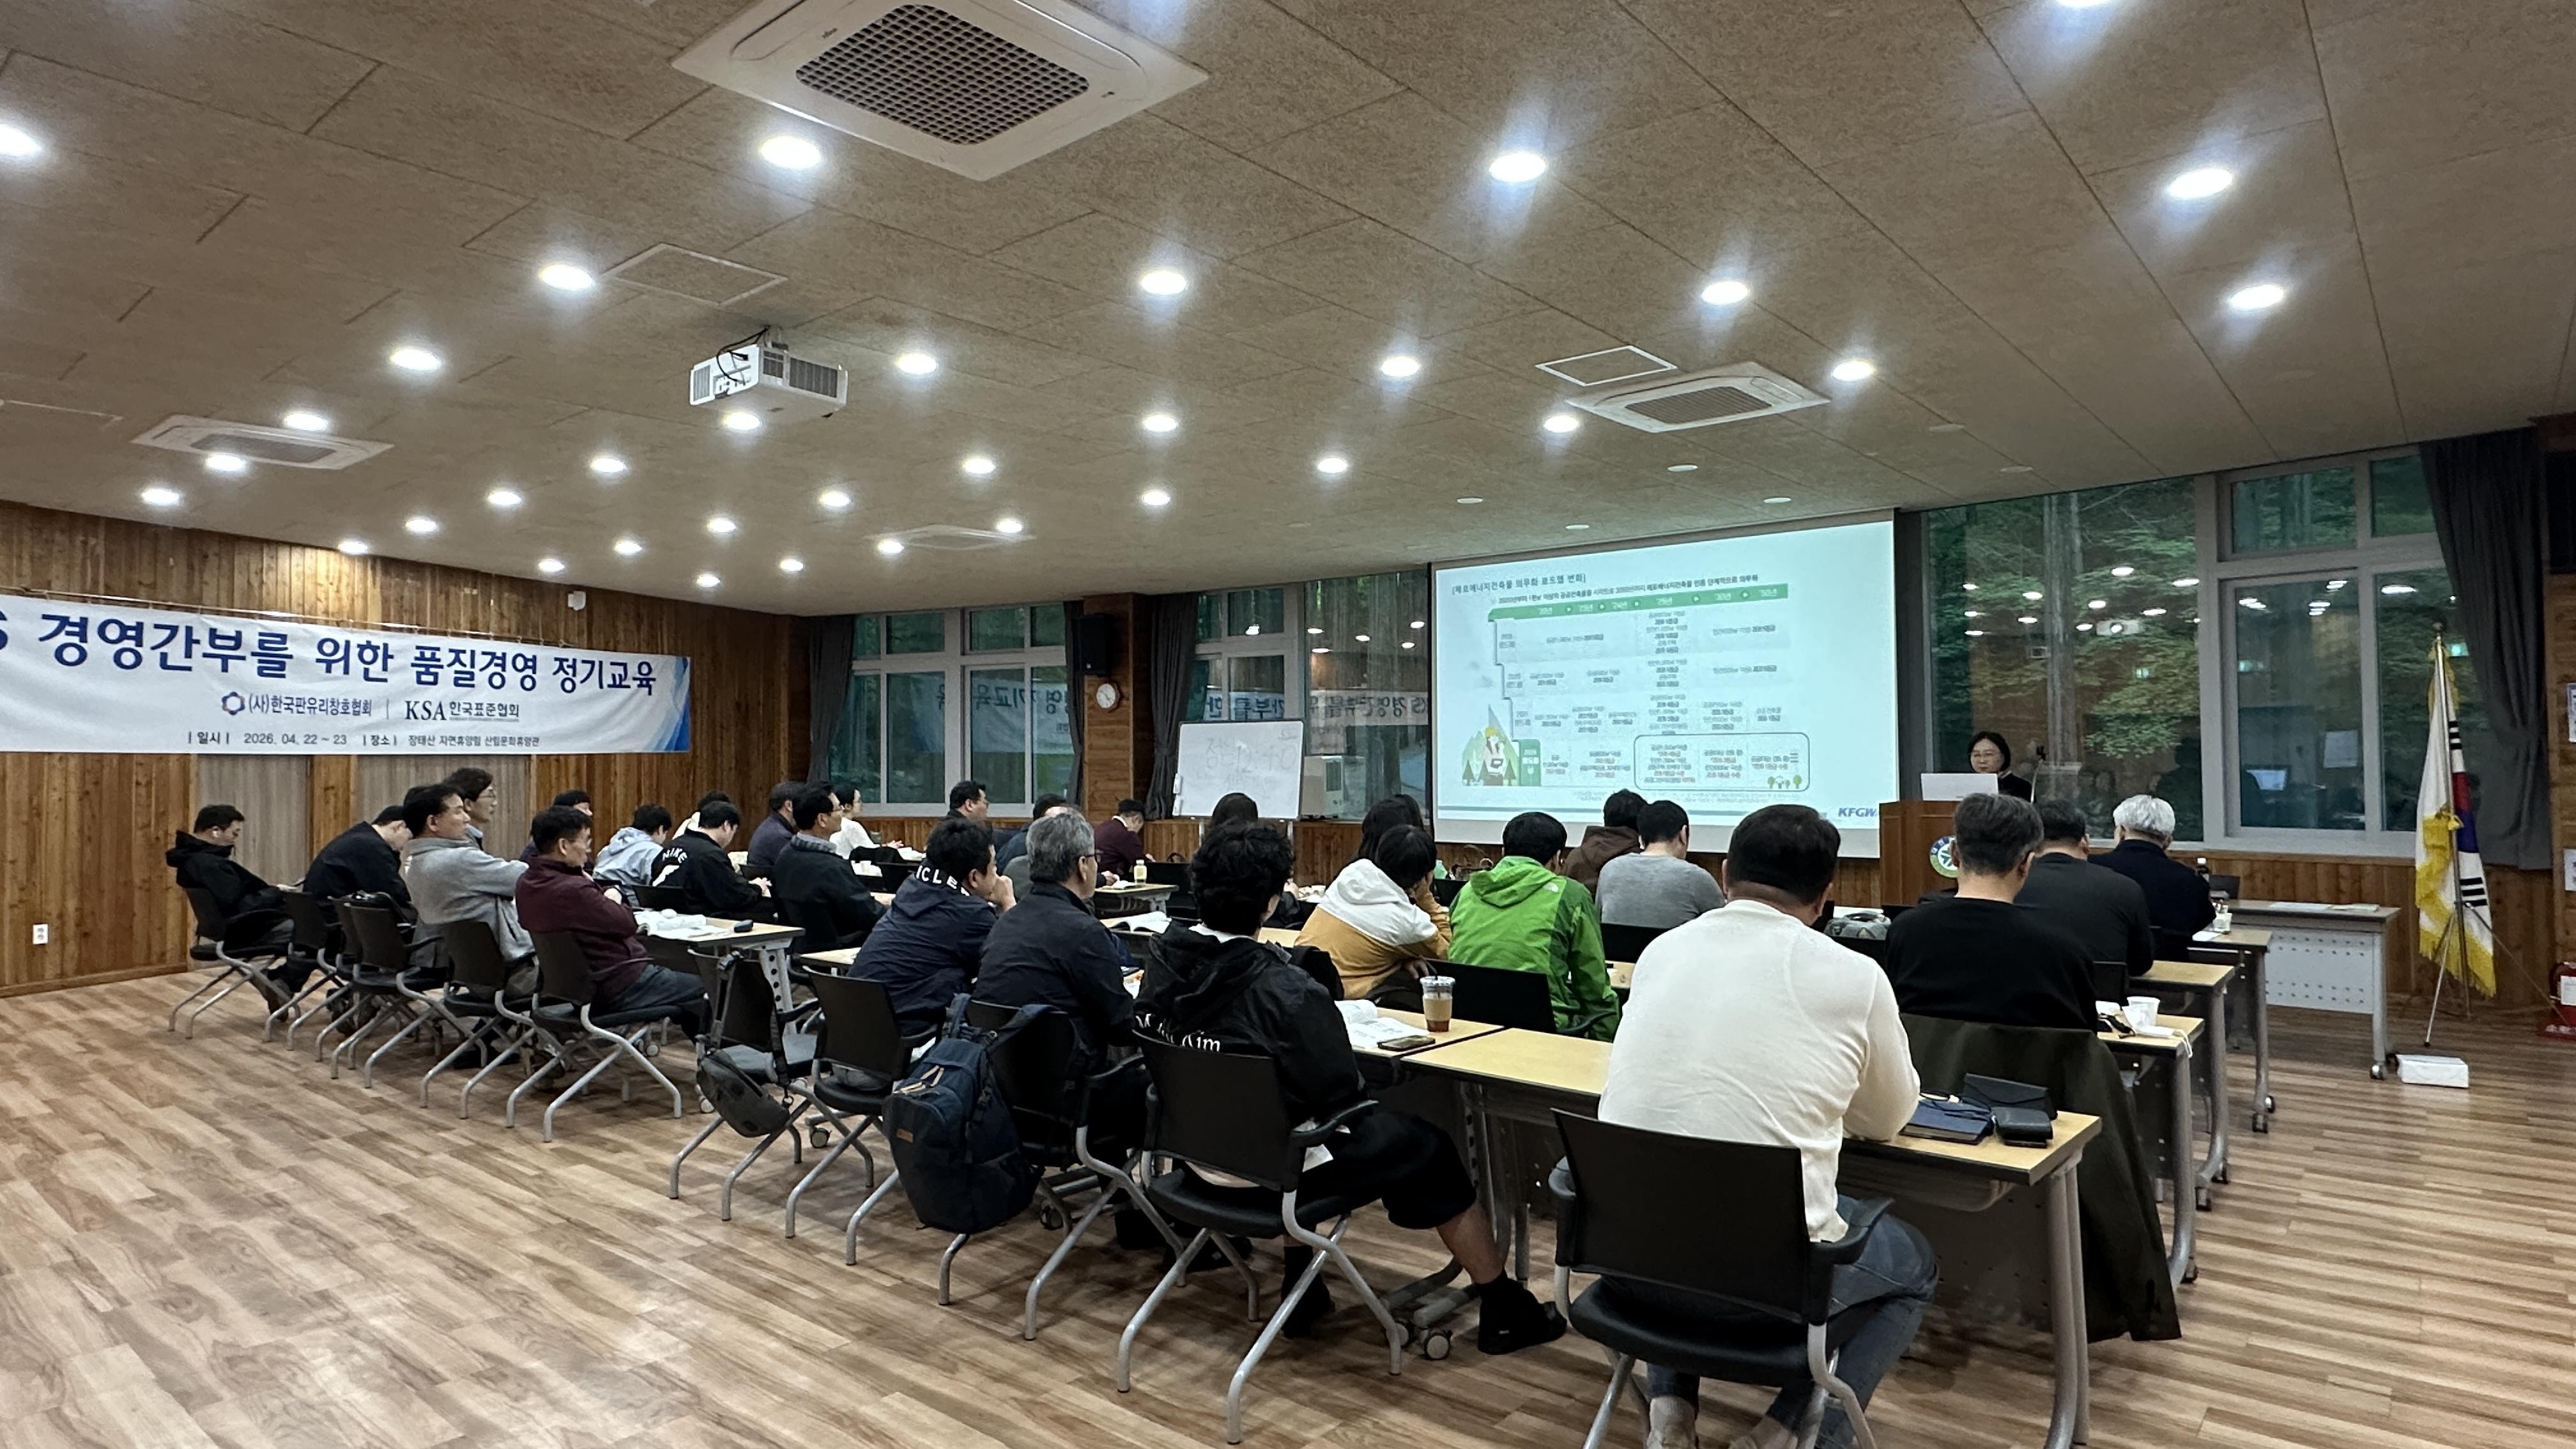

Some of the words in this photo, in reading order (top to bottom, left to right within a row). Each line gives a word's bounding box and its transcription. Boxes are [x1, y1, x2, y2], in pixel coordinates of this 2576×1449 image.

[38, 614, 293, 678] 경영간부를
[316, 638, 394, 683] 위한
[411, 645, 538, 691] 품질경영
[553, 657, 656, 696] 정기교육
[249, 693, 372, 716] (사)한국판유리창호협회
[405, 700, 447, 721] KSA
[450, 702, 519, 718] 한국표준협회
[197, 732, 221, 745] 일시
[244, 733, 277, 745] 2026.
[281, 733, 298, 745] 04.
[304, 733, 319, 744] 22
[333, 734, 347, 745] 23
[371, 735, 390, 746] 장소
[1838, 808, 1878, 817] KFGW
[662, 848, 687, 863] NIKE
